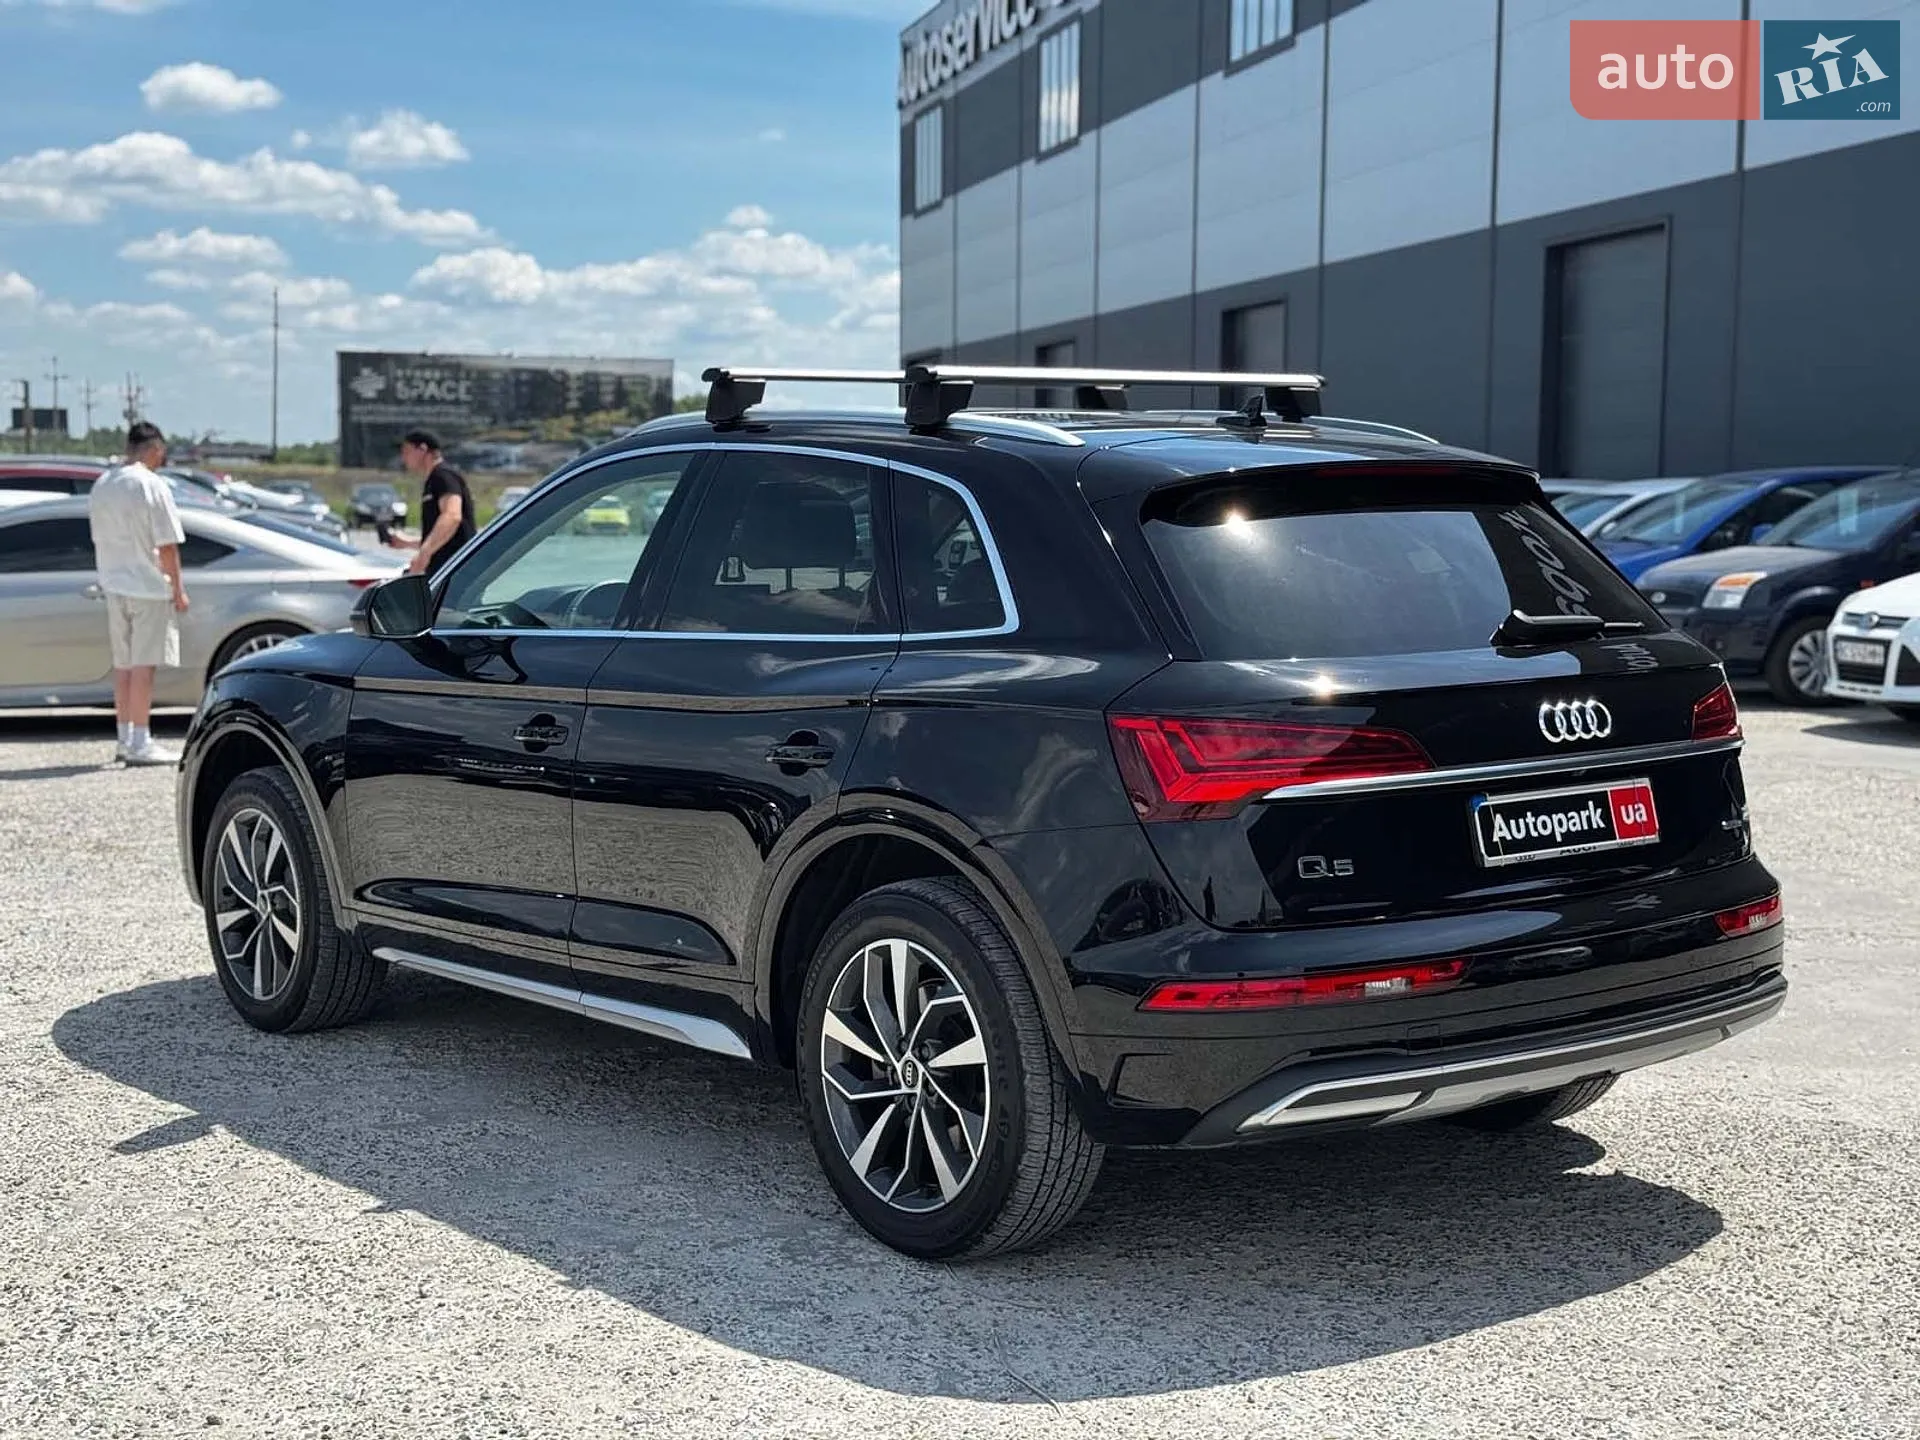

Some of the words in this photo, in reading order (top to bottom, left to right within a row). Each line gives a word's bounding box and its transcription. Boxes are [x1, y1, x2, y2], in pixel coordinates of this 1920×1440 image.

[1492, 800, 1606, 843] Autopark
[1620, 802, 1648, 825] ua
[1297, 855, 1354, 879] Q5
